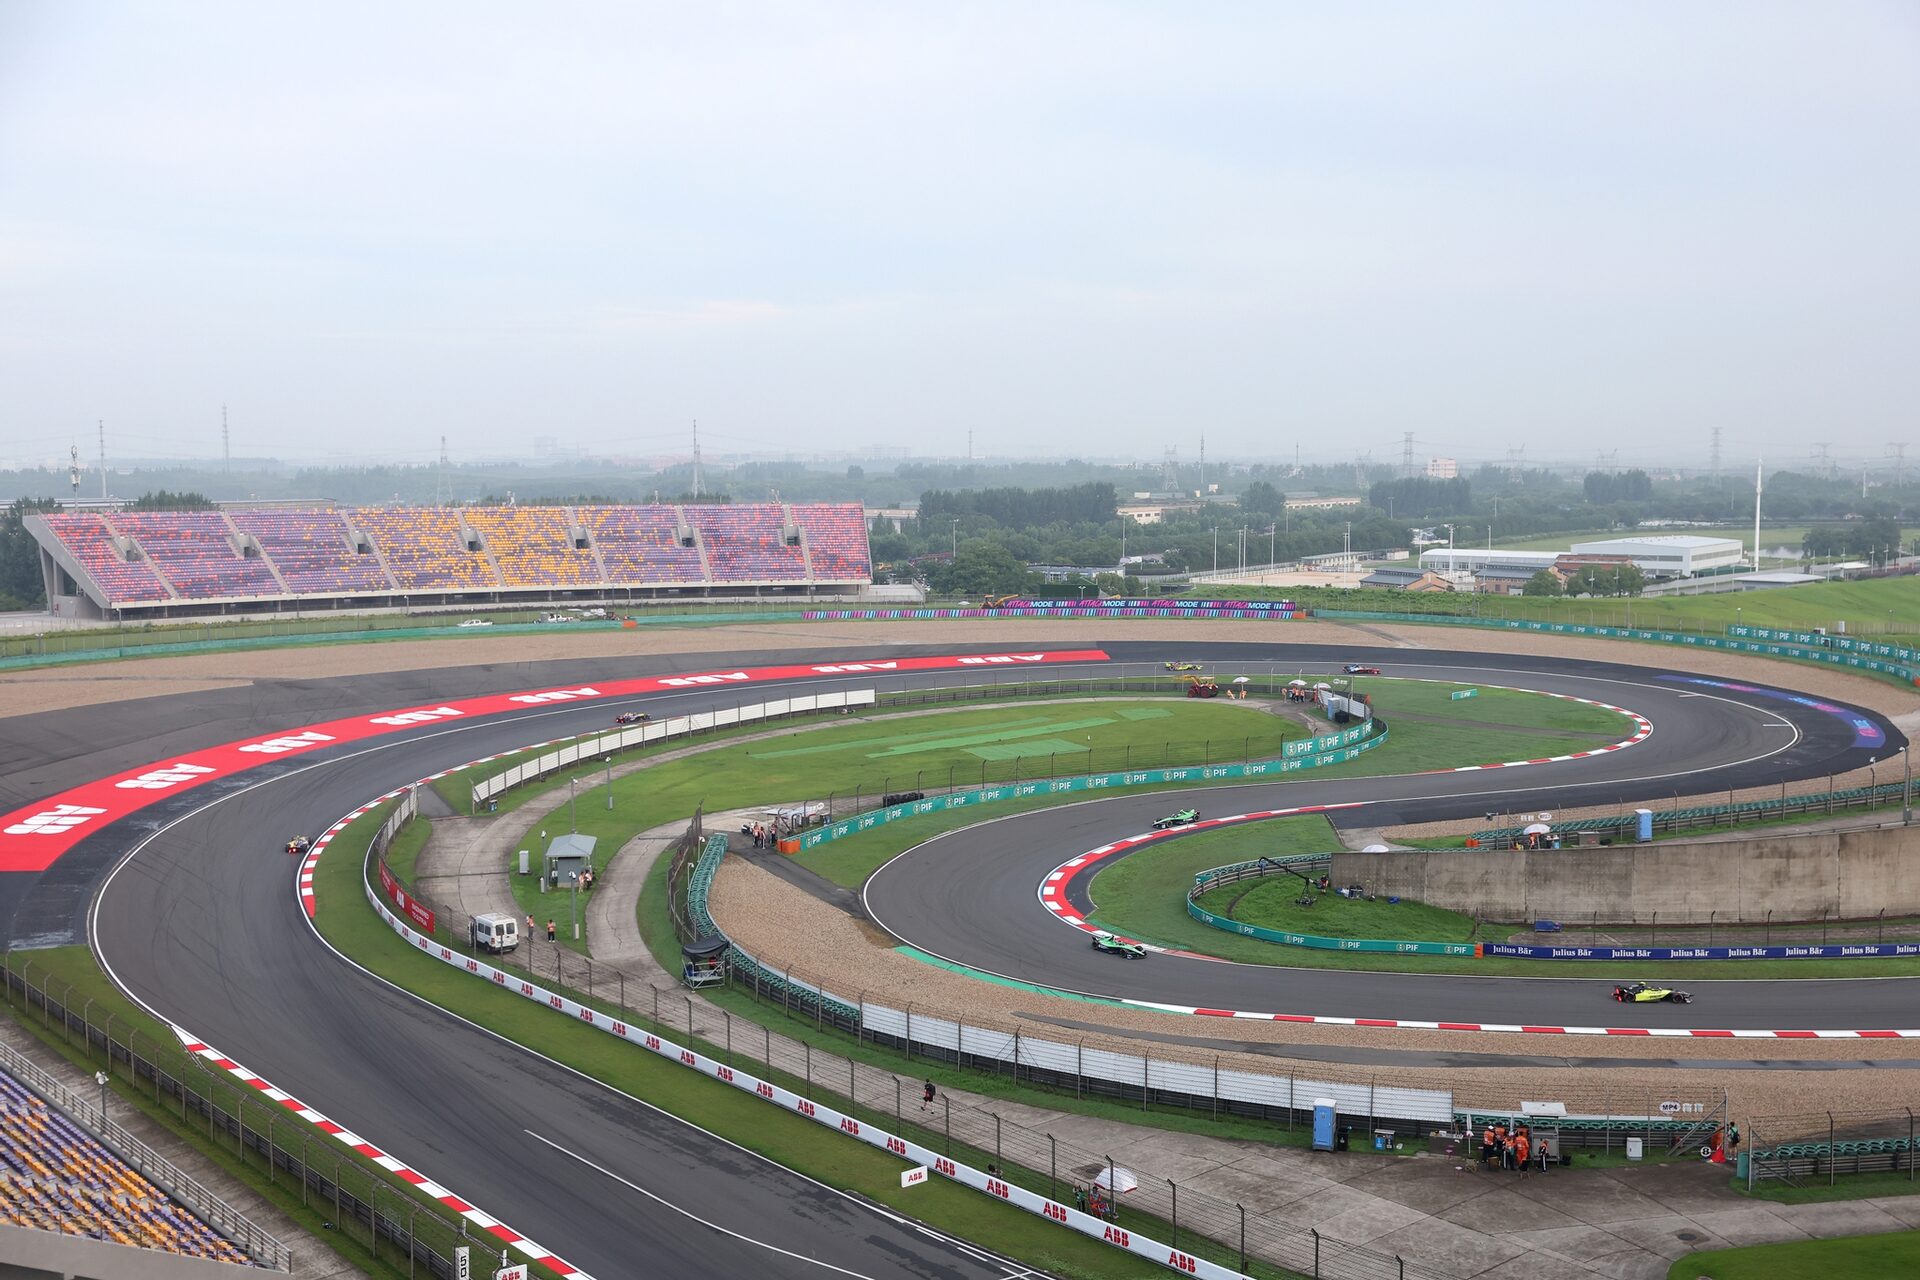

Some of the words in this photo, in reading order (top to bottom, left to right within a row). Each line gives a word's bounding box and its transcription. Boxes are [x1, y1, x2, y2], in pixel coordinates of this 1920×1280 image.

[1841, 640, 1850, 648] PIF
[1880, 647, 1889, 655] PIF
[957, 654, 1045, 664] ABB
[812, 662, 897, 672] ABB
[657, 672, 750, 685] ABB
[508, 688, 602, 703] ABB
[369, 707, 464, 726] ABB
[1350, 730, 1359, 740] PIF
[238, 731, 336, 753] ABB
[1297, 742, 1312, 752] PIF
[1328, 736, 1339, 747] PIF
[1290, 760, 1302, 768] PIF
[1324, 755, 1334, 764] PIF
[1253, 765, 1266, 774] PIF
[115, 763, 216, 789] ABB
[1096, 778, 1108, 786] PIF
[1134, 774, 1146, 782] PIF
[1023, 786, 1035, 794] PIF
[1059, 782, 1071, 790] PIF
[954, 797, 966, 806] PIF
[988, 791, 999, 800] PIF
[921, 803, 932, 812] PIF
[3, 804, 108, 834] ABB
[892, 810, 902, 819] PIF
[865, 818, 874, 828] PIF
[839, 826, 848, 836] PIF
[813, 834, 821, 844] PIF
[419, 937, 427, 949] ABB
[1897, 945, 1917, 953] Julius
[441, 948, 451, 960] ABB
[1612, 950, 1634, 958] Julius
[467, 959, 477, 971] ABB
[493, 972, 504, 984] ABB
[522, 983, 533, 995] ABB
[550, 996, 562, 1009] ABB
[580, 1009, 593, 1022] ABB
[612, 1022, 626, 1035] ABB
[646, 1035, 660, 1050] ABB
[681, 1050, 695, 1065] ABB
[717, 1066, 733, 1082] ABB
[756, 1082, 773, 1098] ABB
[798, 1100, 815, 1116] ABB
[841, 1118, 859, 1135] ABB
[887, 1136, 906, 1155] ABB
[935, 1157, 955, 1177] ABB
[908, 1172, 922, 1182] ABB
[987, 1178, 1008, 1198] ABB
[1043, 1202, 1067, 1222] ABB
[1104, 1226, 1129, 1247] ABB
[1169, 1251, 1196, 1273] ABB
